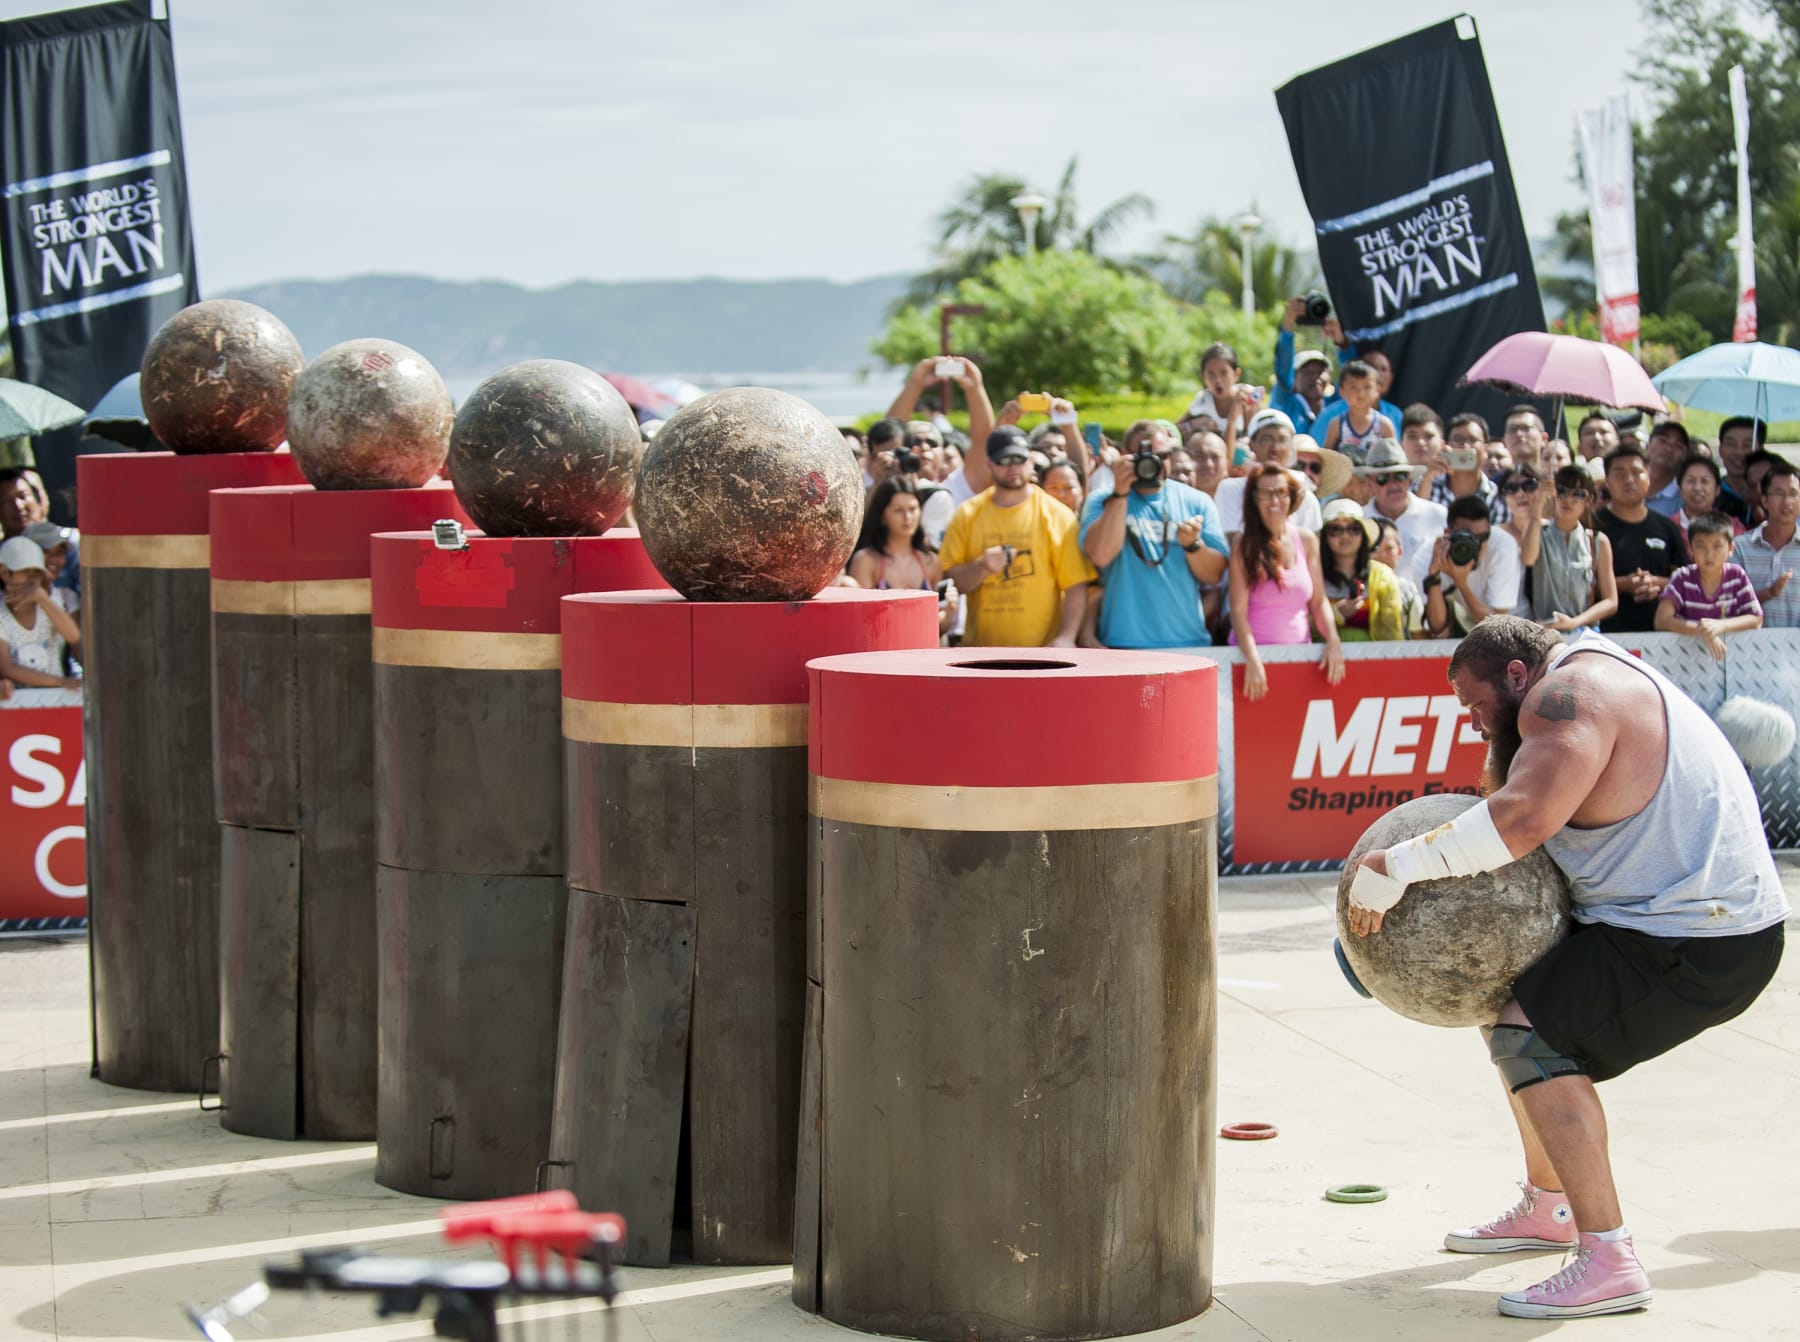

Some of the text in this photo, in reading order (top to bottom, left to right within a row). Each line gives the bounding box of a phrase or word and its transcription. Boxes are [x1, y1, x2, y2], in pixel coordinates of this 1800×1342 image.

[29, 179, 158, 223] THE WORLD'S
[33, 198, 161, 248] STRONGEST
[42, 222, 164, 296] MAN
[1354, 227, 1395, 253] THE
[1372, 234, 1482, 319] MAN
